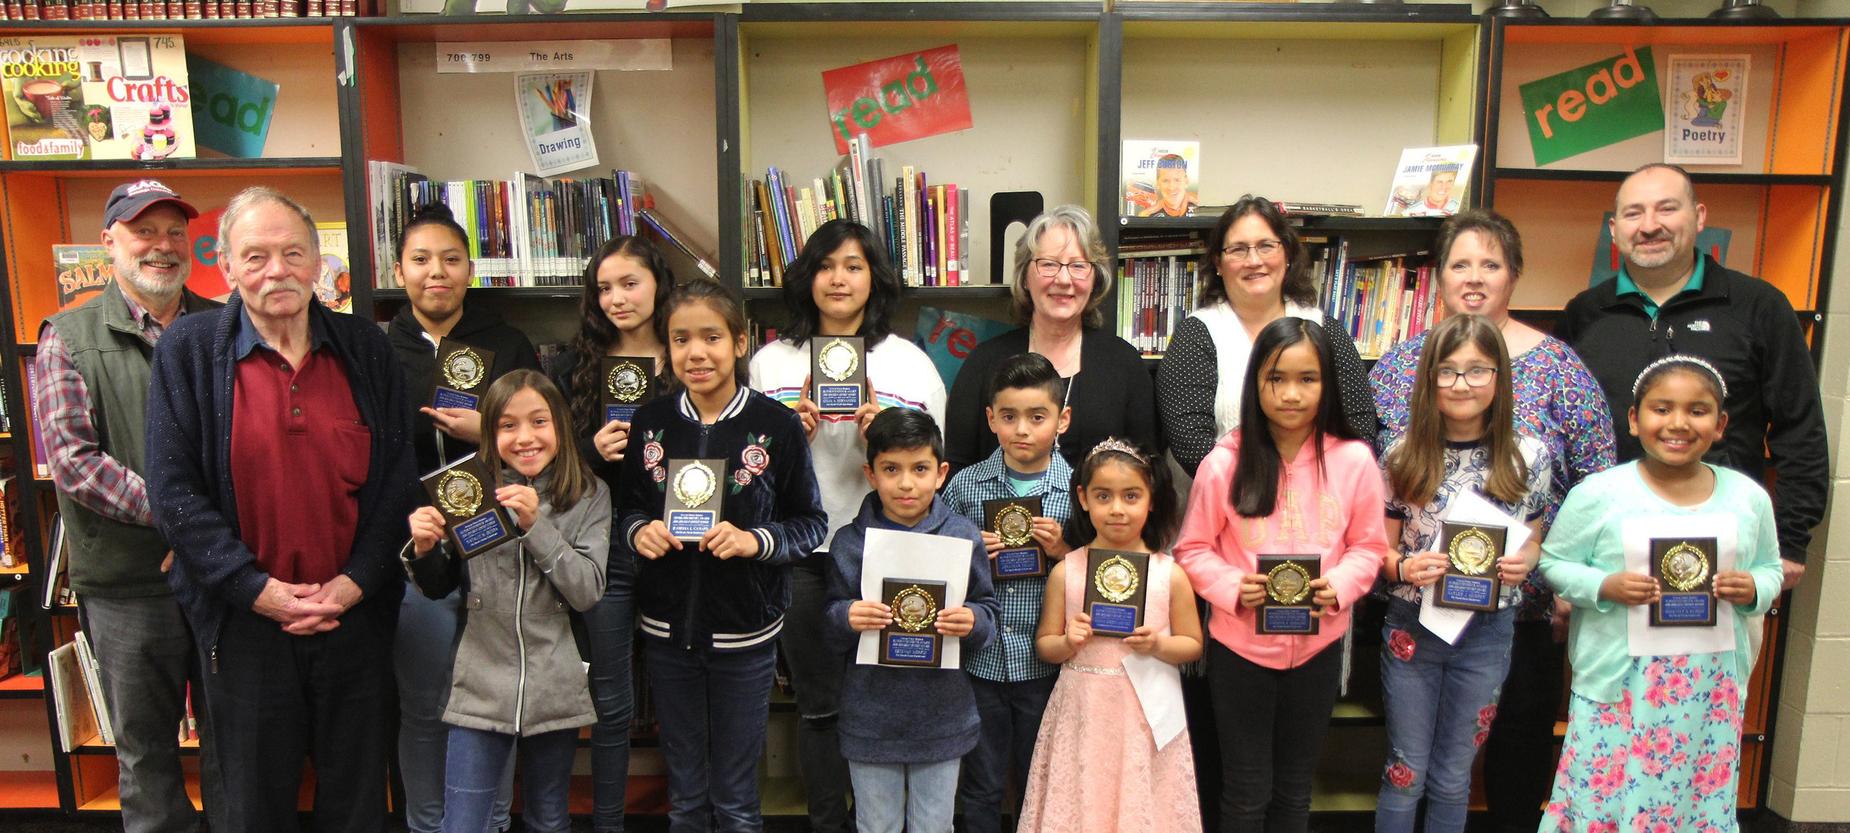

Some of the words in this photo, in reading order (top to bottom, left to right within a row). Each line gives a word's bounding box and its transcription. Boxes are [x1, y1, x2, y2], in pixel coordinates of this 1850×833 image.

[529, 52, 549, 61] The
[553, 51, 574, 61] Arts
[2, 55, 80, 80] cooking
[107, 75, 189, 103] Crafts
[835, 56, 940, 141] read
[1534, 42, 1645, 139] read
[538, 136, 581, 155] Drawing
[1682, 128, 1726, 145] Poetry
[1137, 159, 1155, 169] JEFF
